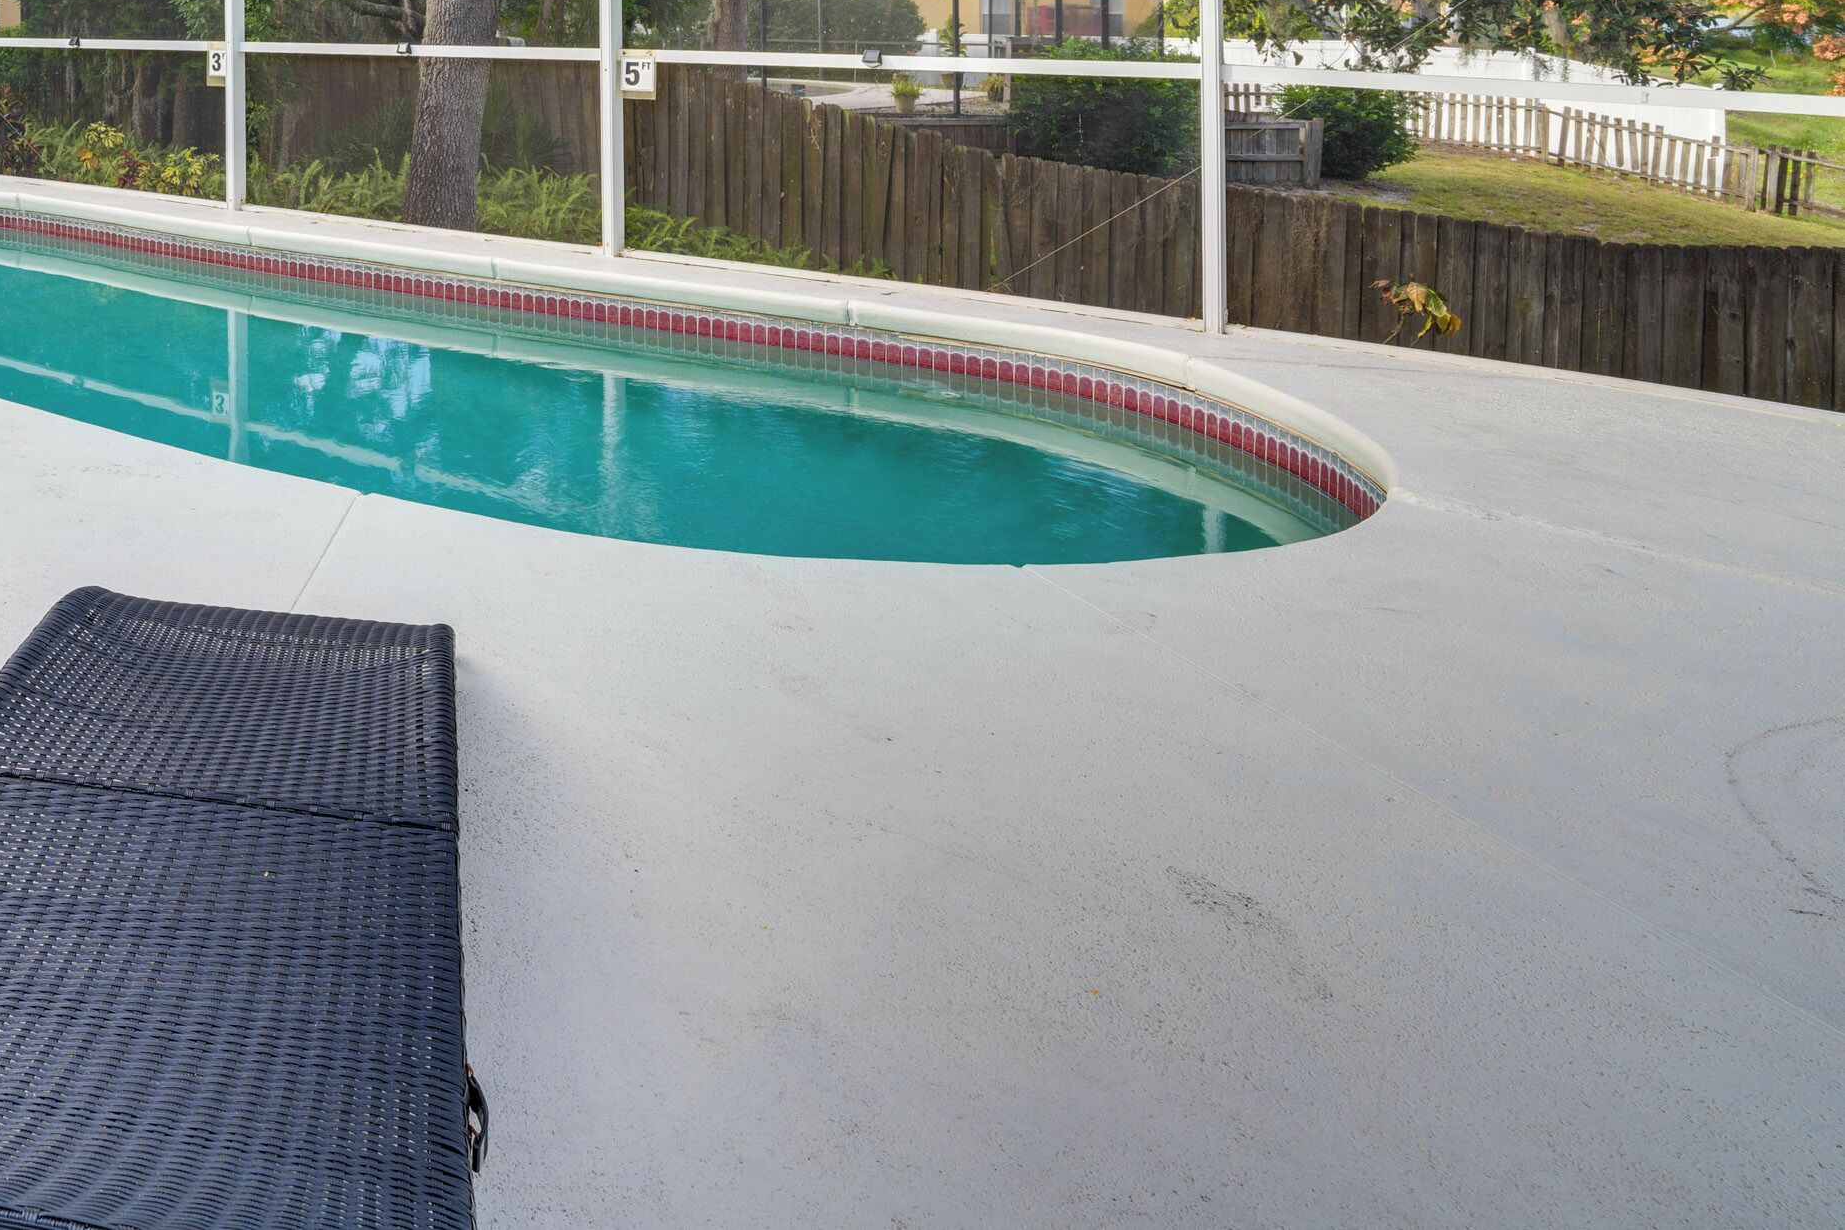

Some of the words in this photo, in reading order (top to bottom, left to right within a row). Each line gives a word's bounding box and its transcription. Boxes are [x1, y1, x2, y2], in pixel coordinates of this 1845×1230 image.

[212, 52, 222, 72] 3
[625, 61, 640, 86] 5
[641, 61, 652, 71] FT
